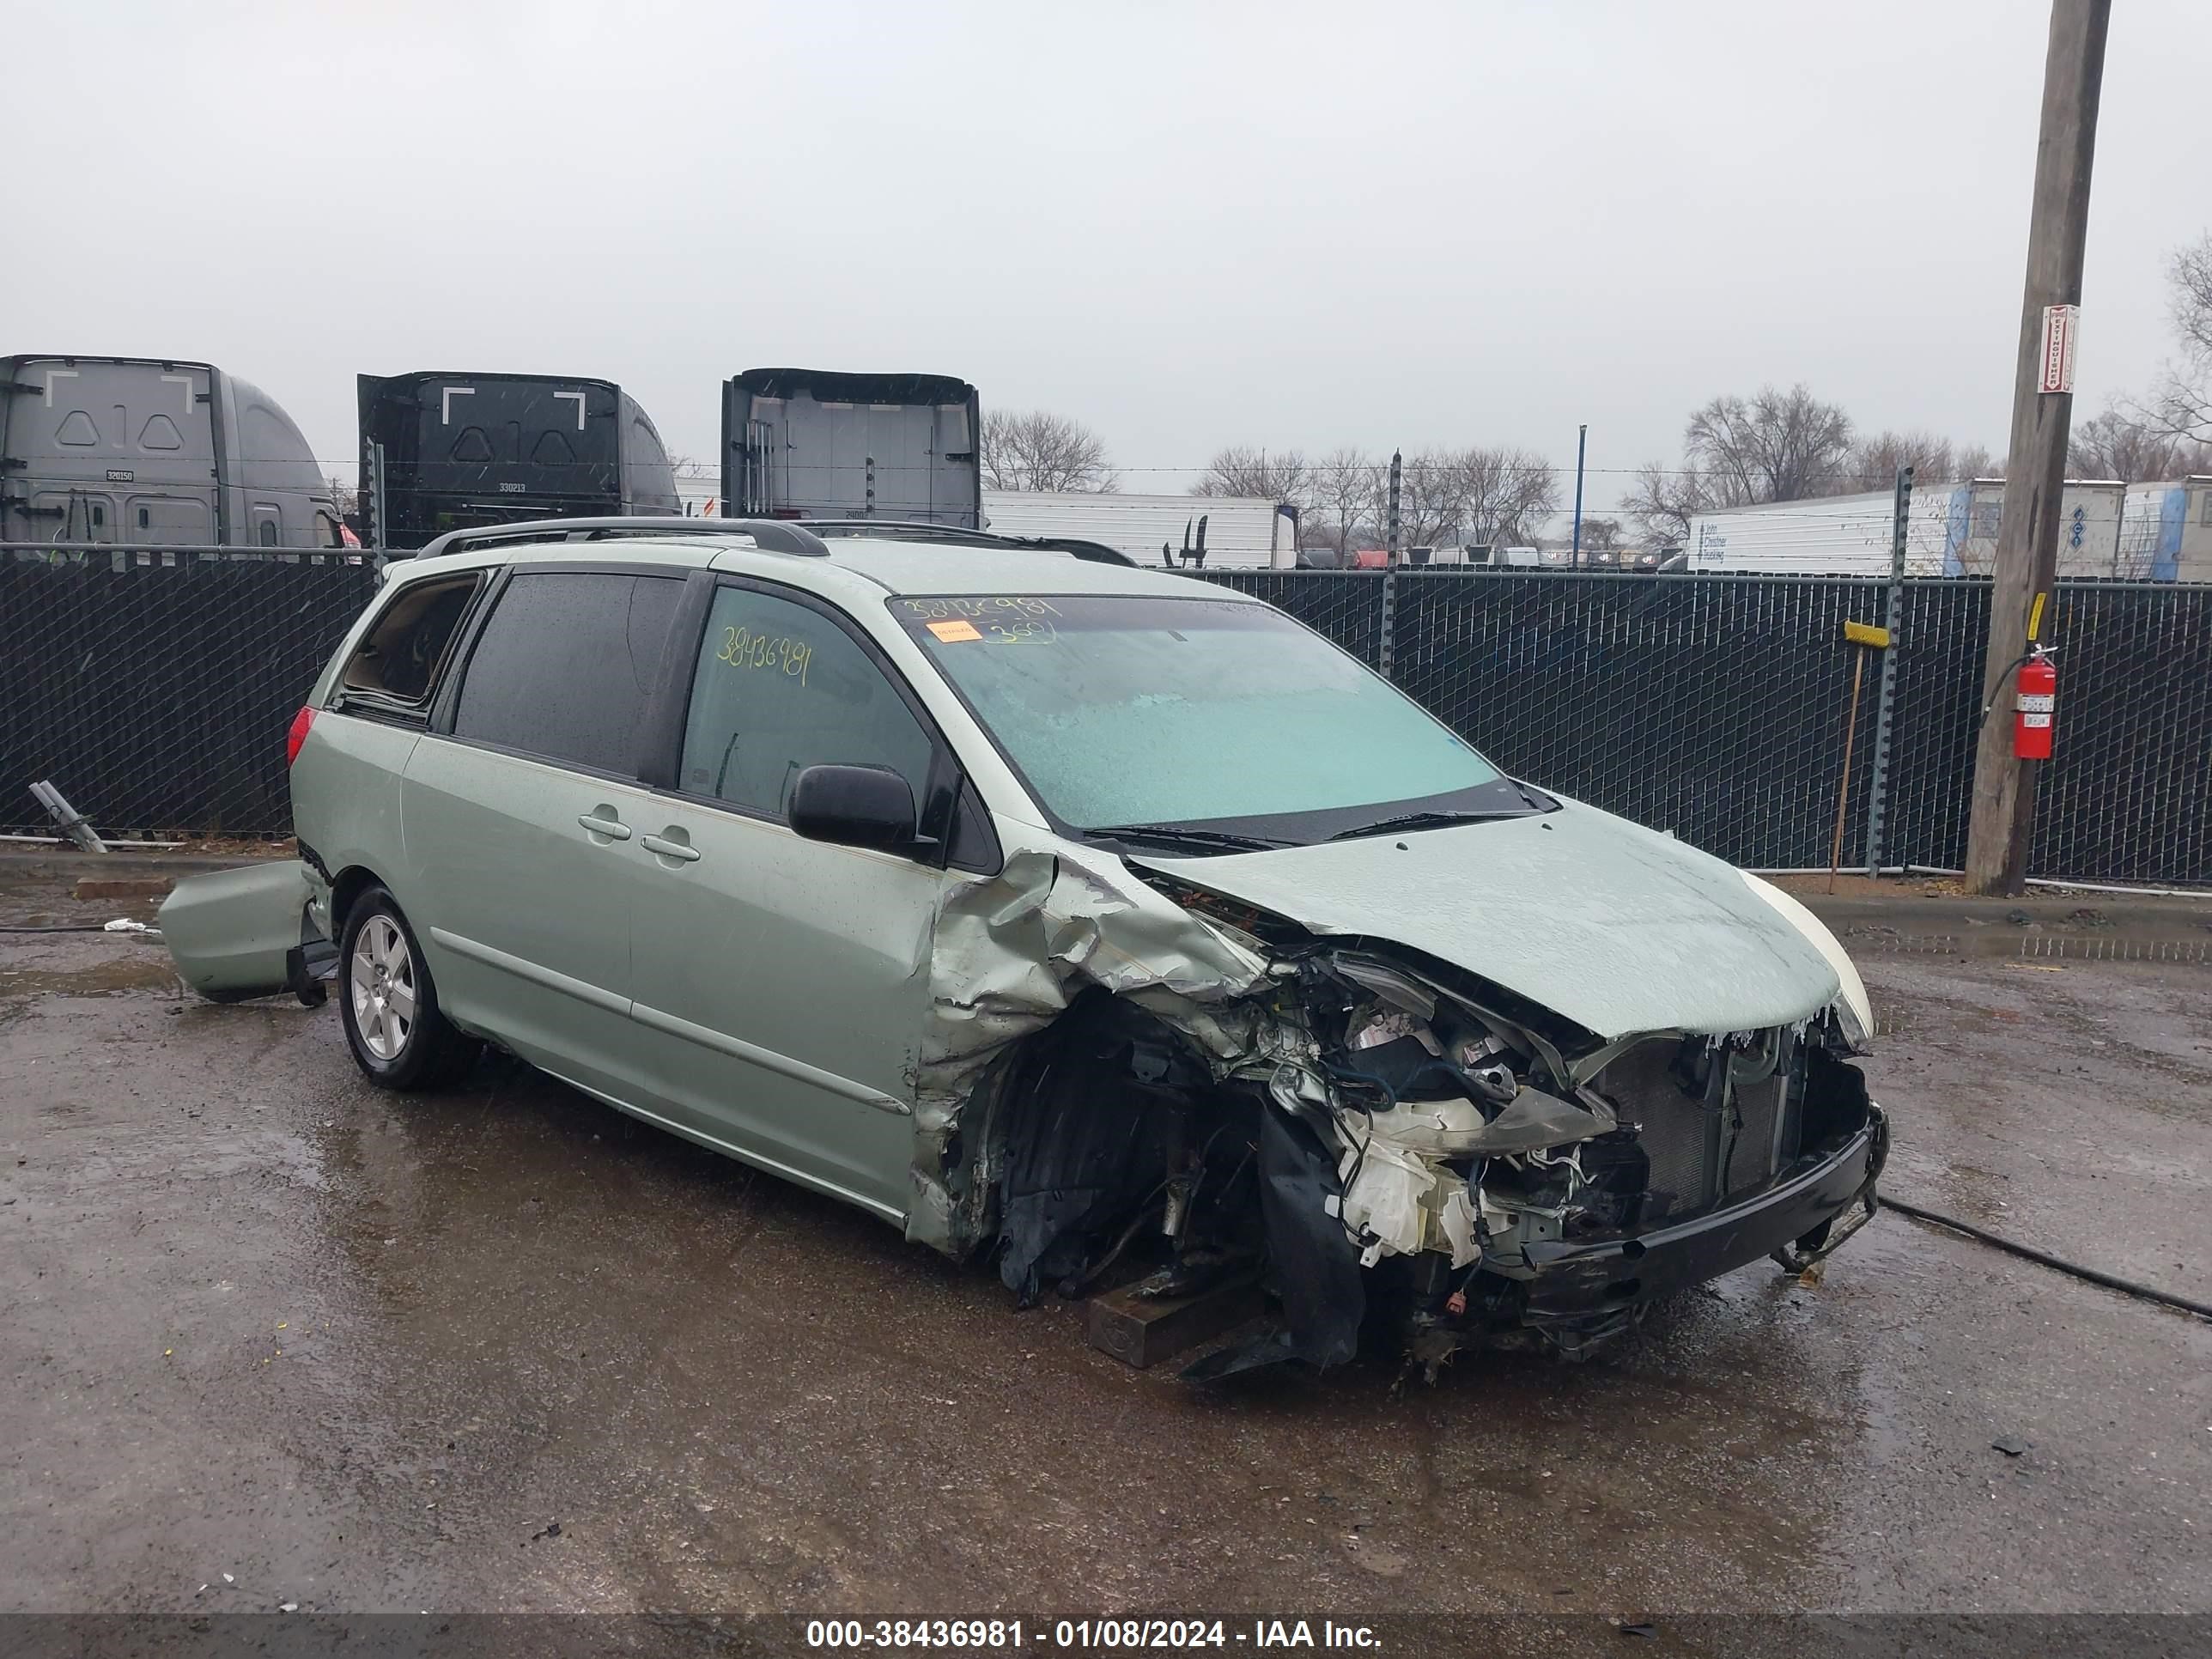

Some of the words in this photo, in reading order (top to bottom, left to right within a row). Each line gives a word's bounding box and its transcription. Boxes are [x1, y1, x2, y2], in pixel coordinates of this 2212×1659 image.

[2050, 319, 2062, 385] EXTINGUISHER
[107, 471, 132, 481] 320150
[499, 482, 526, 493] 330213
[717, 626, 811, 688] 38436981
